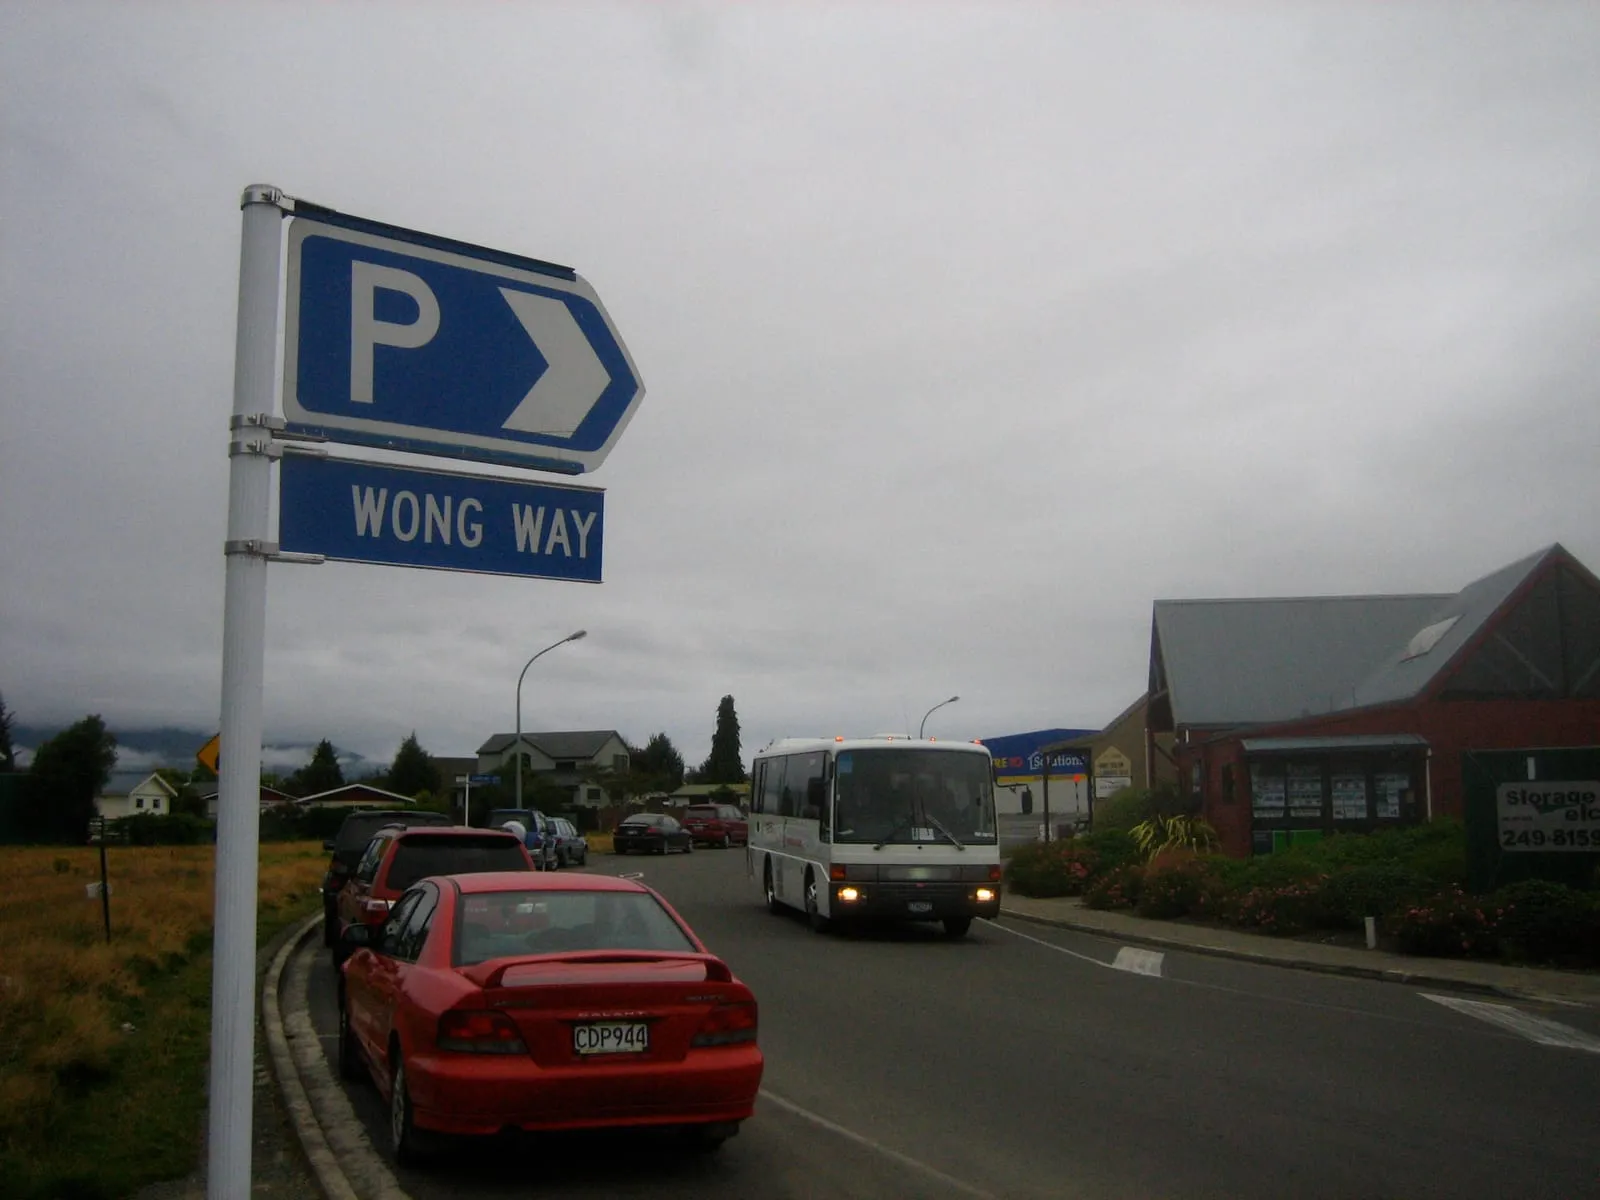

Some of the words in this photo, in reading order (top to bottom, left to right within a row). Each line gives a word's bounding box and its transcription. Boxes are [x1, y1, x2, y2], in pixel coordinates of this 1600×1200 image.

[350, 259, 441, 405] P
[351, 484, 484, 548] WONG
[512, 503, 598, 559] WAY
[1506, 788, 1597, 806] Storage
[576, 1026, 646, 1048] CDP944
